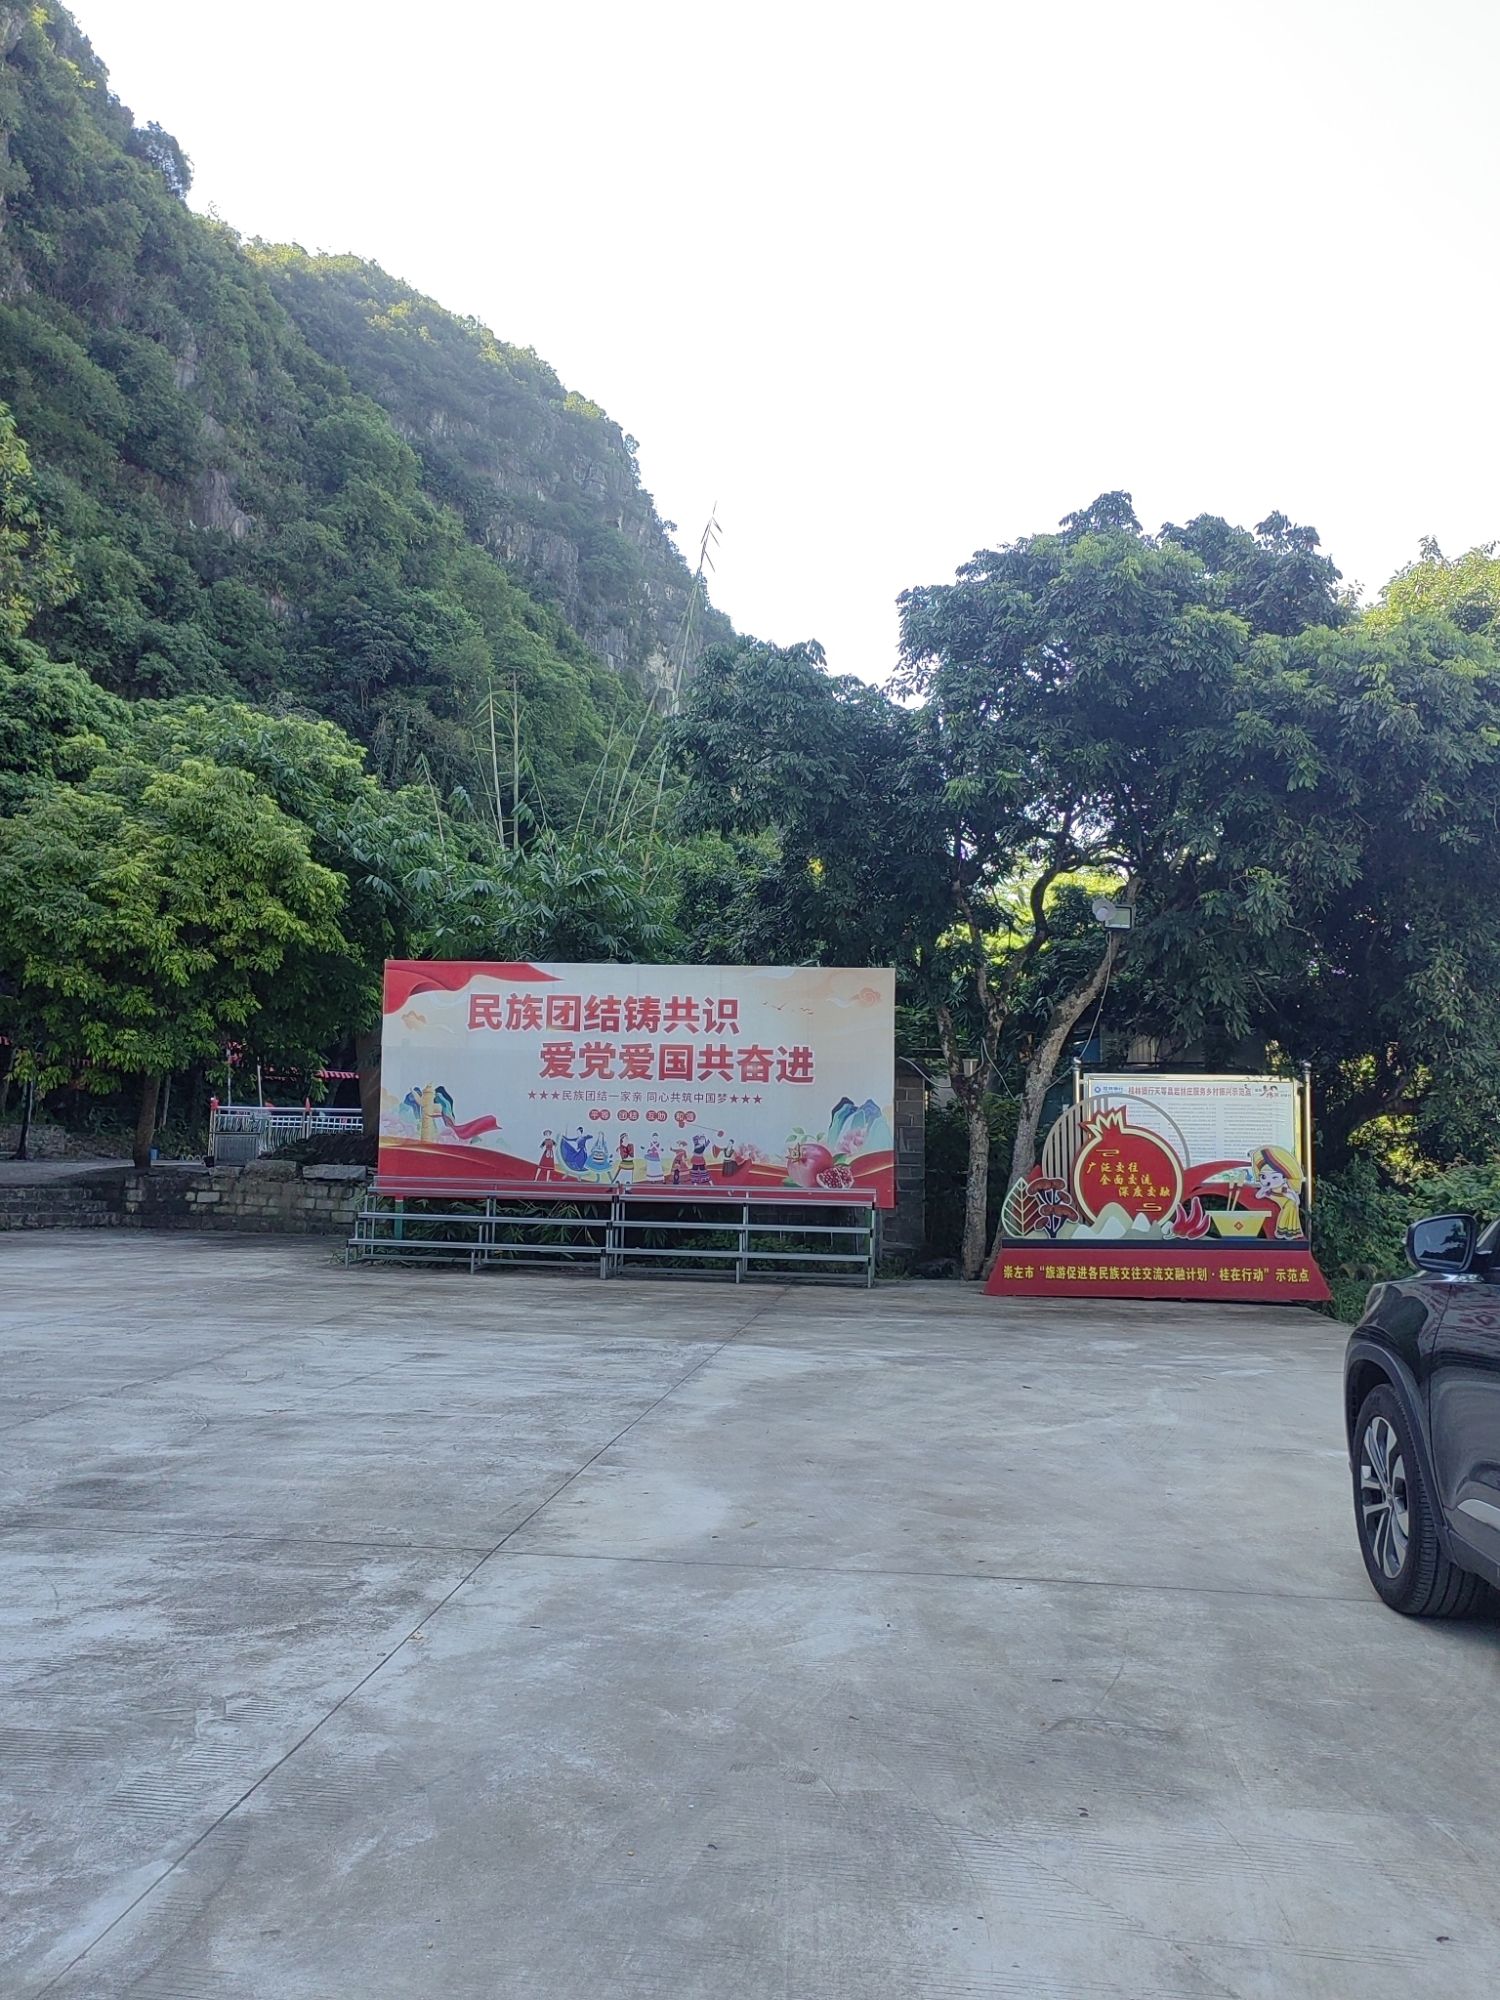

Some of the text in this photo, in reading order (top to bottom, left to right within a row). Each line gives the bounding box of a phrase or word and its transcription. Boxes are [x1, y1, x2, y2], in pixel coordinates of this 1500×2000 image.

[467, 993, 740, 1034] 民族团结铸共识
[539, 1041, 815, 1084] 爱党爱国共奋进
[562, 1090, 728, 1104] 民族团结一家亲 同心共筑中国梦
[619, 1111, 638, 1120] 团结
[647, 1111, 667, 1121] 互助
[1086, 1161, 1139, 1174] 广泛交往
[1099, 1174, 1153, 1185] 全面交流
[1118, 1186, 1171, 1198] 深度交融
